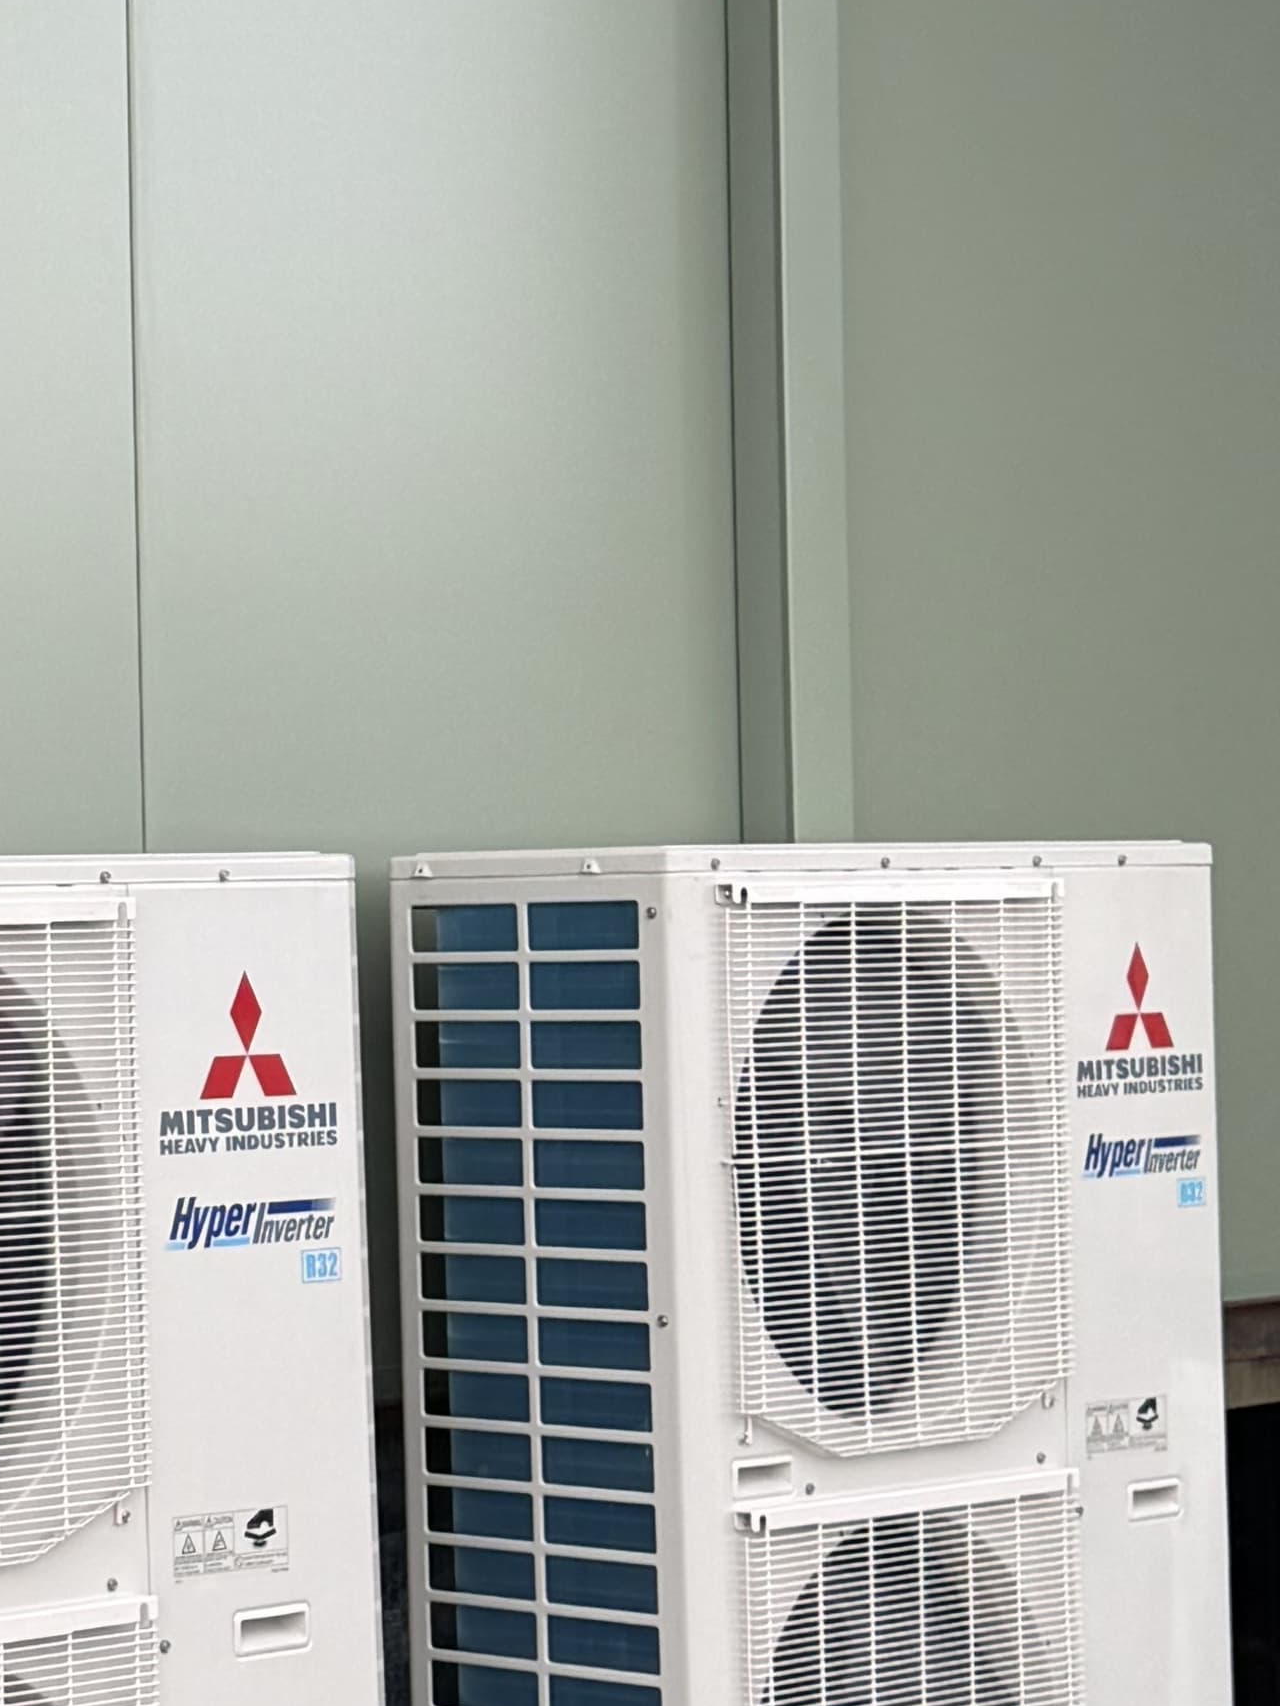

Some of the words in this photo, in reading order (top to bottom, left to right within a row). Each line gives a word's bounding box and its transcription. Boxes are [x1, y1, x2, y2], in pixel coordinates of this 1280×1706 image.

[1077, 1053, 1203, 1082] MITSUBISHI
[1077, 1082, 1119, 1098] HEAVY
[1123, 1077, 1203, 1095] INDUSTRIES
[159, 1102, 337, 1136] MITSUBISHI
[159, 1137, 220, 1155] HEAVY
[225, 1130, 338, 1152] INDUSTRIES
[1084, 1133, 1145, 1178] Hyper
[1144, 1139, 1200, 1173] Inverter
[169, 1197, 257, 1249] Hyper
[253, 1202, 335, 1244] Inverter
[305, 1253, 338, 1279] R32
